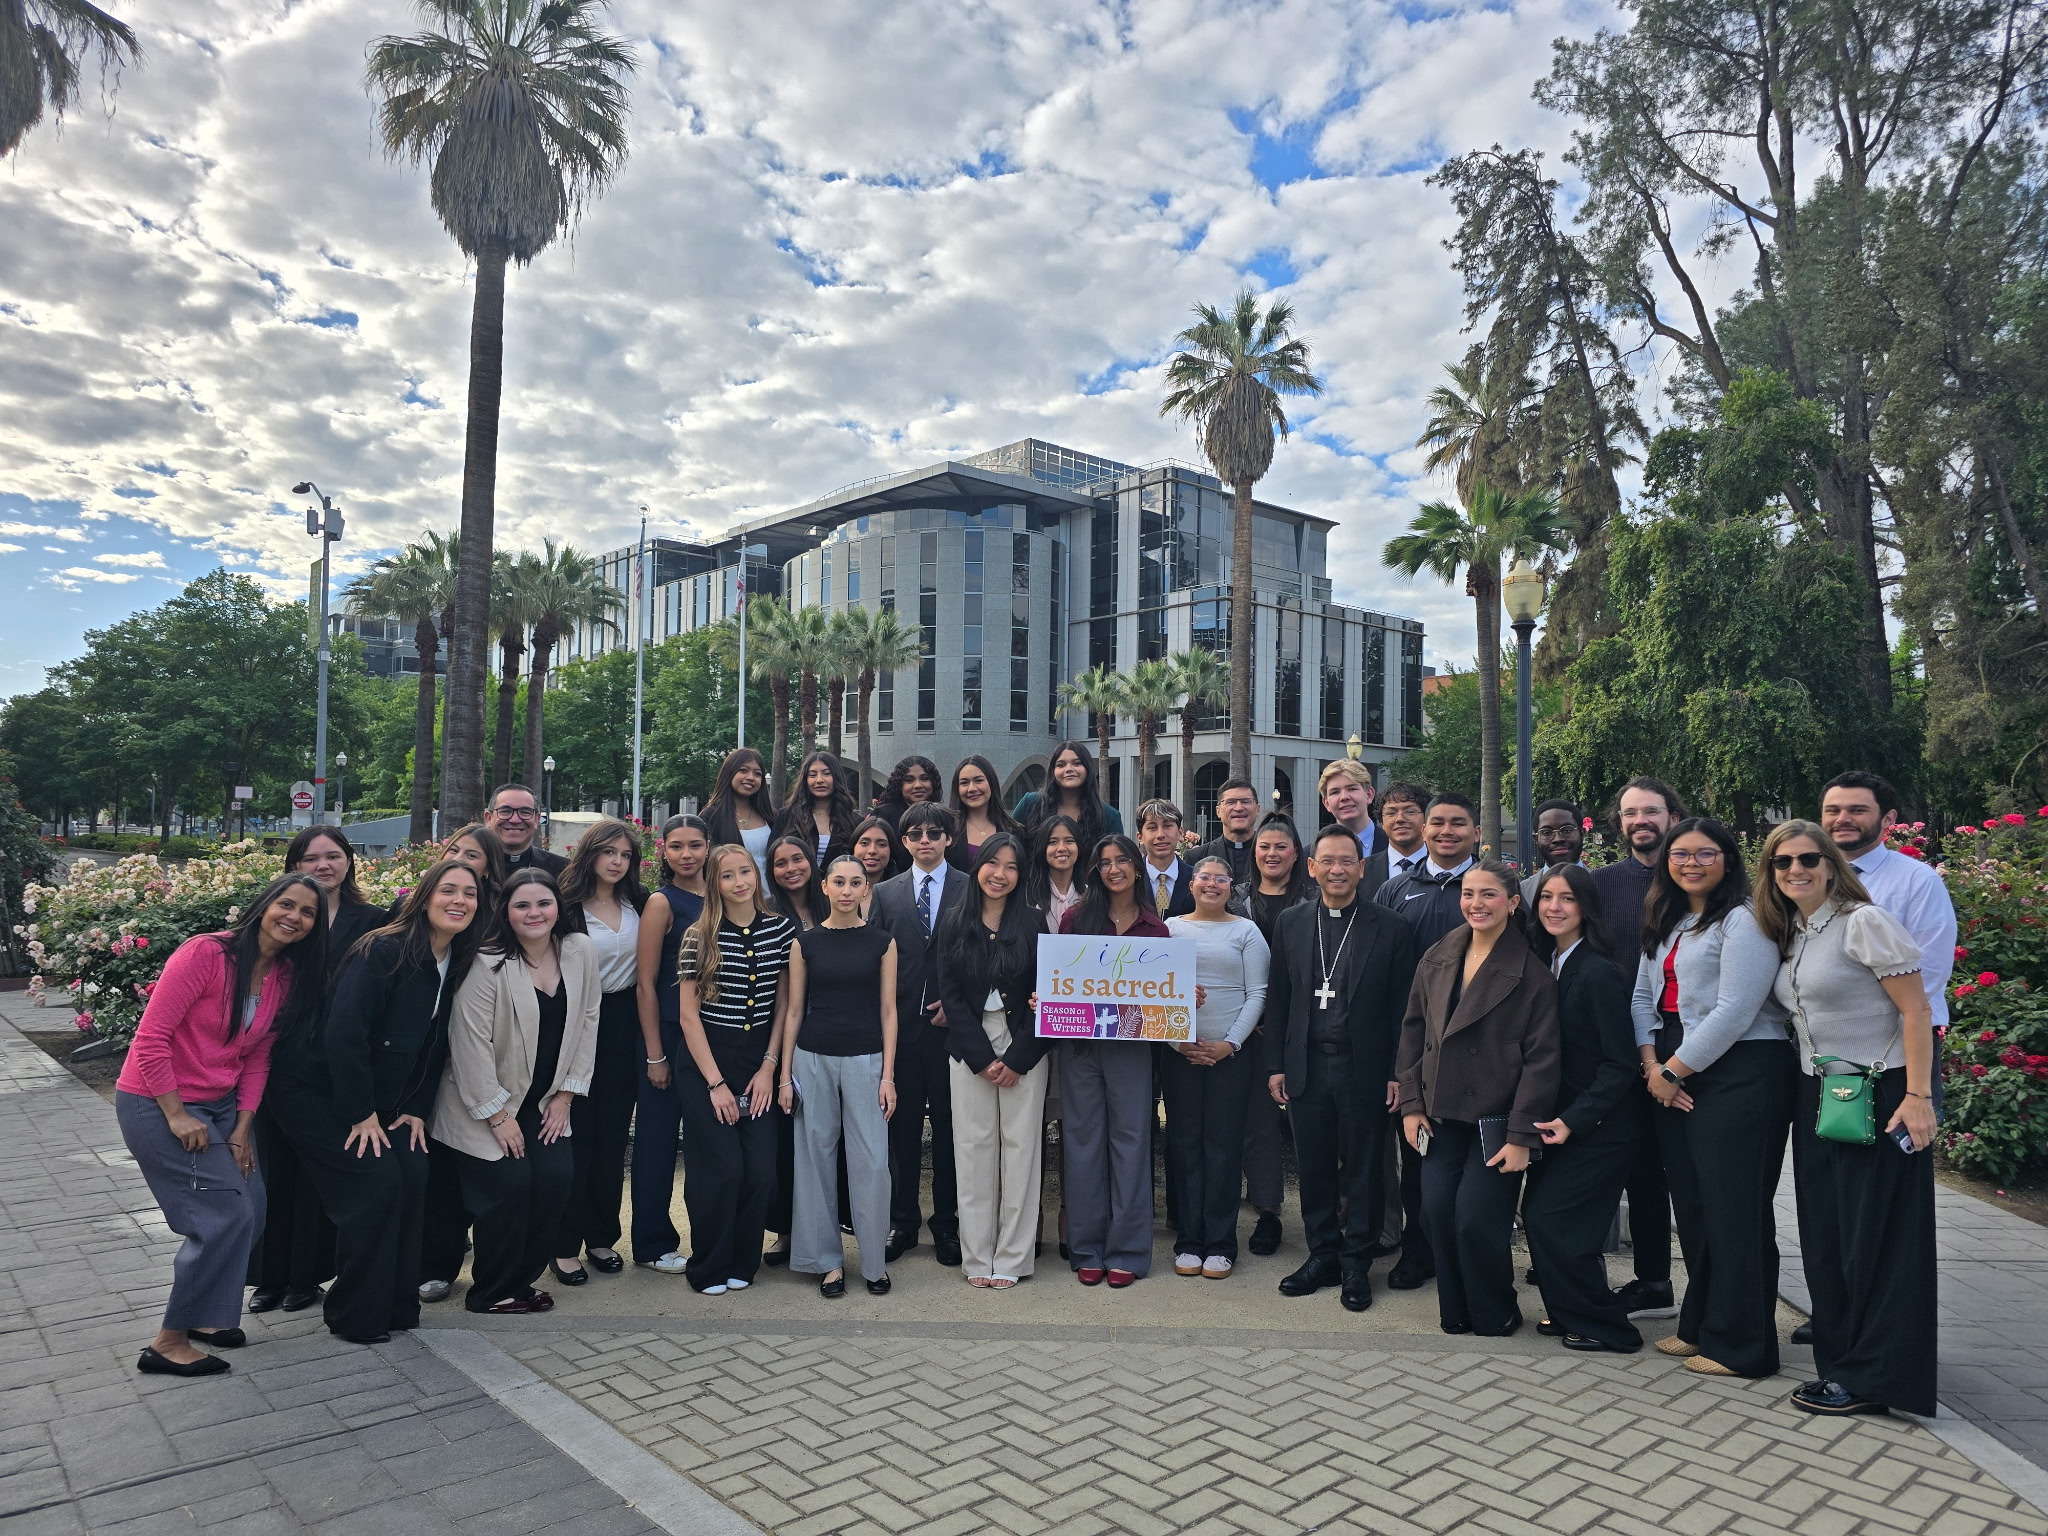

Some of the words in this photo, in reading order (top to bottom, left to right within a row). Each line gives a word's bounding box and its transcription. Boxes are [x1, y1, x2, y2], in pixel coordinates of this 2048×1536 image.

[1051, 969, 1075, 995] is
[1082, 972, 1185, 999] sacred.
[1042, 1005, 1075, 1015] SEASON
[1047, 1014, 1088, 1024] FAITHFUL
[1051, 1023, 1092, 1033] WITNESS
